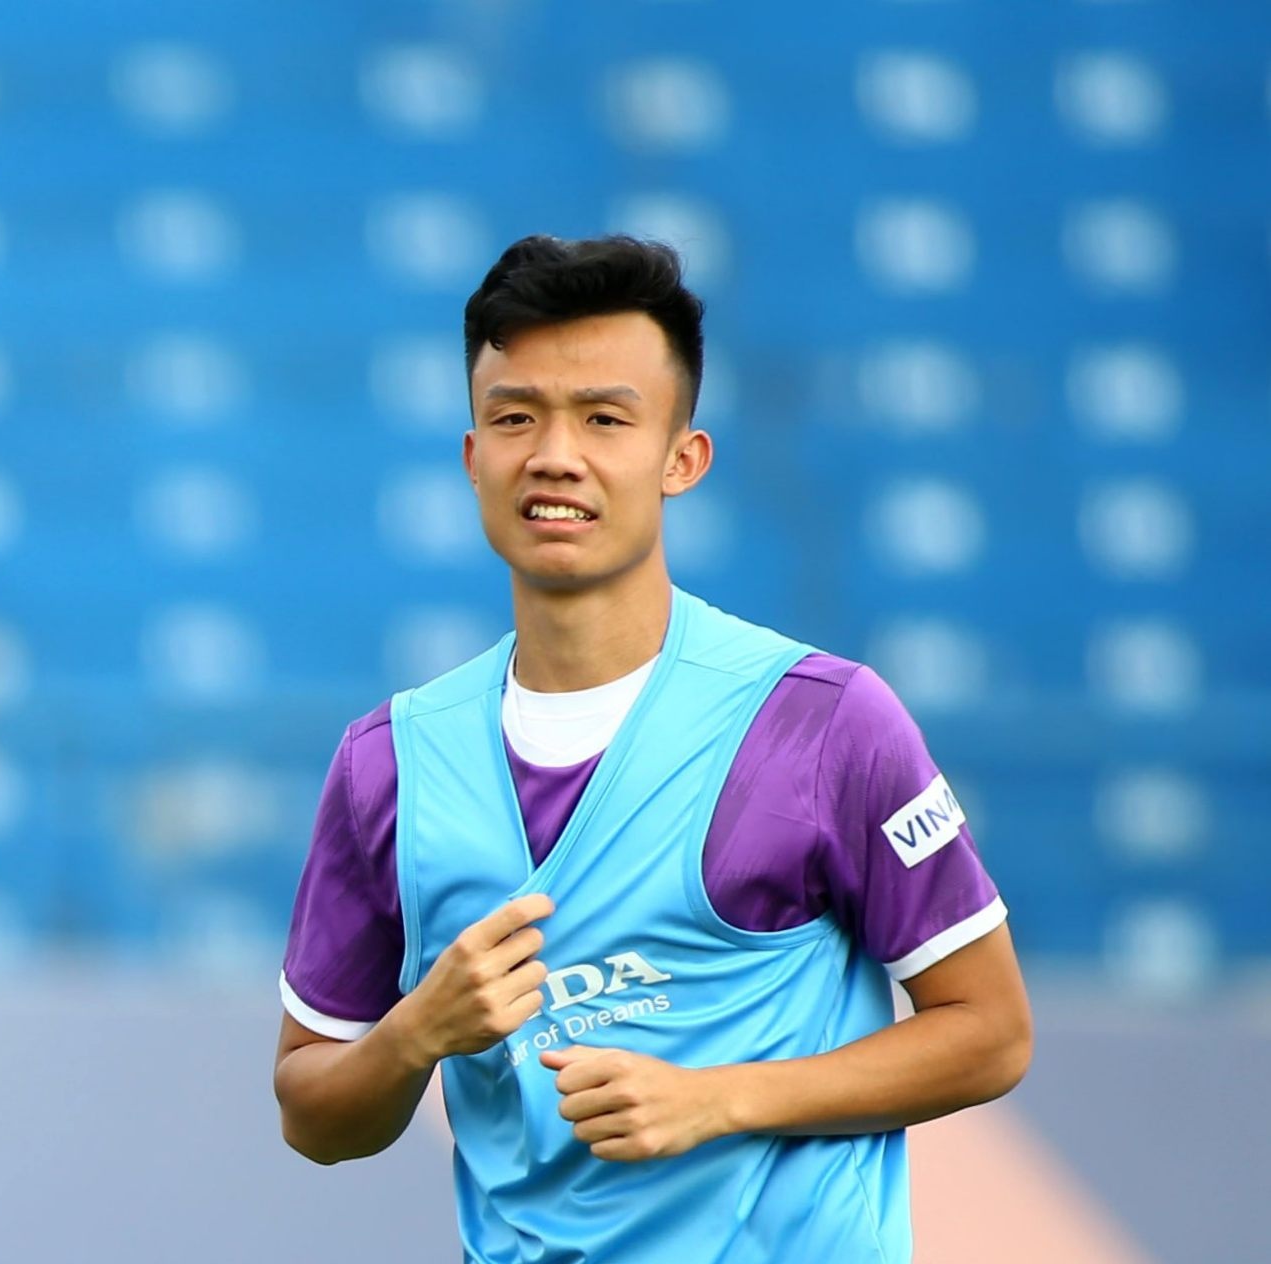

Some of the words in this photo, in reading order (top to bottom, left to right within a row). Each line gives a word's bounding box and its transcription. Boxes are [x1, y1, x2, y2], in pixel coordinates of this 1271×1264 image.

[527, 950, 672, 1020] DA
[532, 1023, 560, 1050] of
[564, 993, 671, 1040] Dreams
